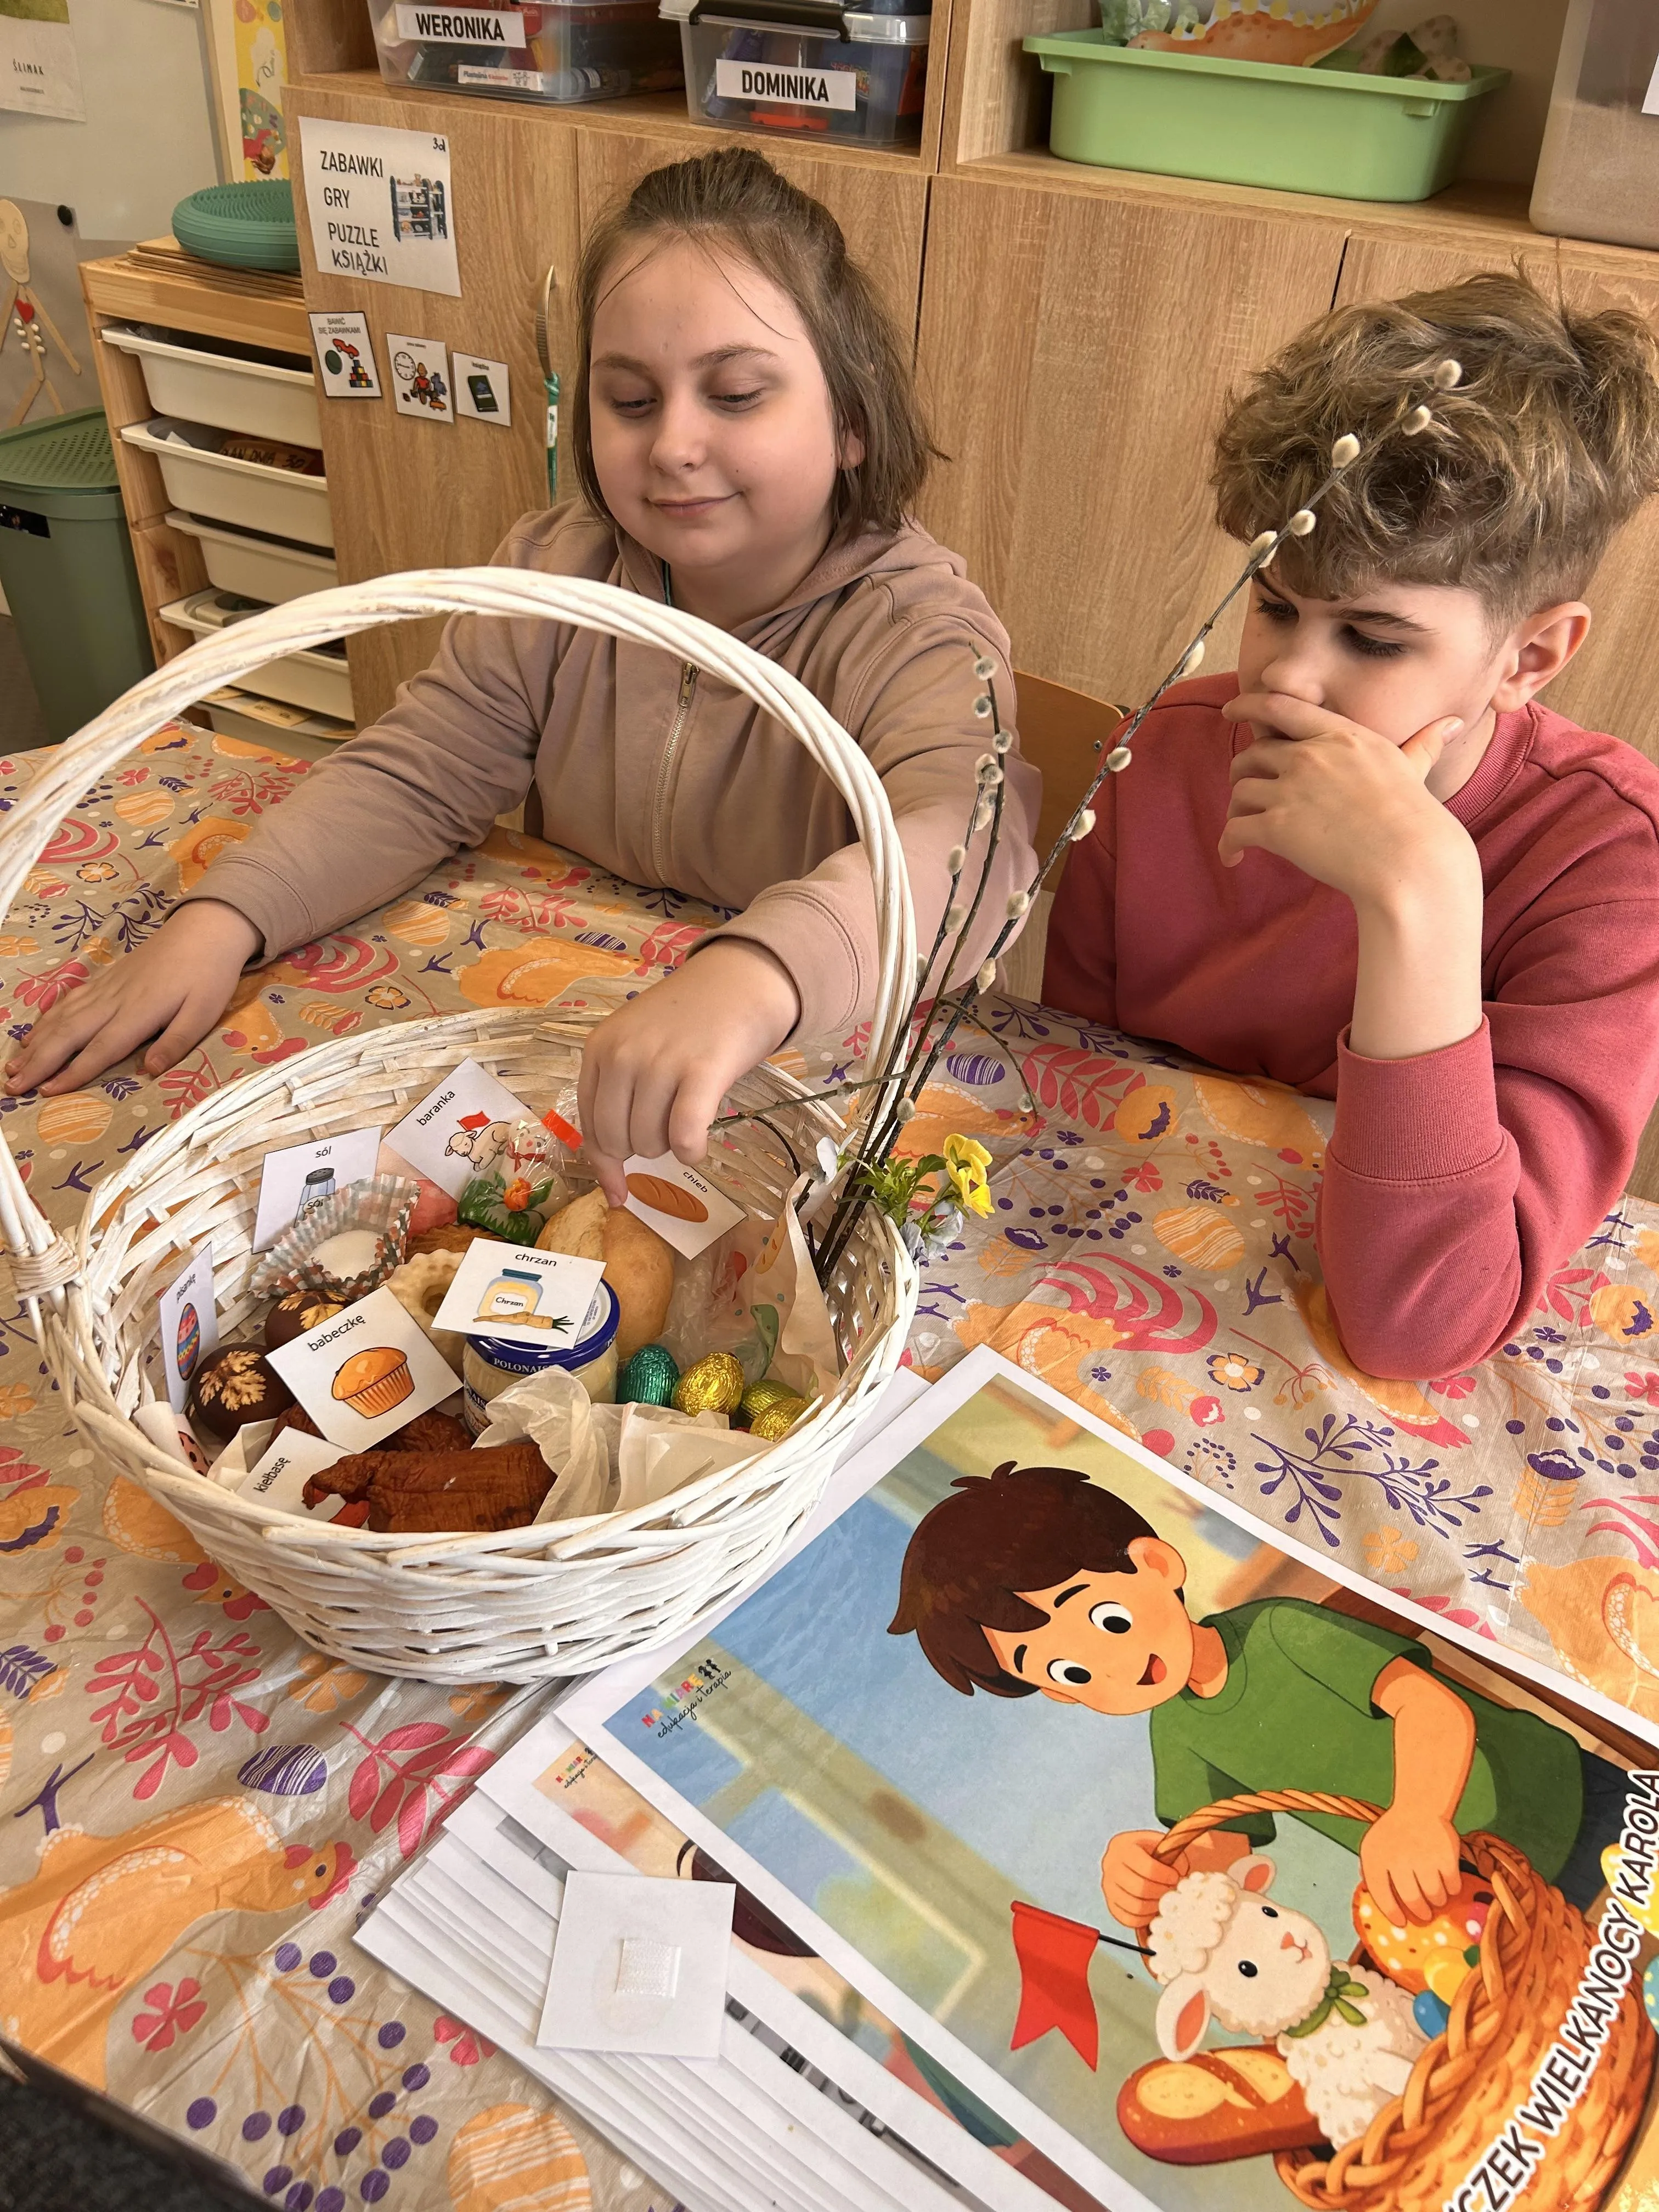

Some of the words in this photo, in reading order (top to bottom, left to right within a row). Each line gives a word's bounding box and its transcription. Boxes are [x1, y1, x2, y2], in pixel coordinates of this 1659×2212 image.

[415, 13, 505, 41] WERONIKA
[13, 58, 44, 75] ŚLIMAK
[742, 70, 829, 102] DOMINIKA
[320, 150, 383, 178] ZABAWKI
[323, 187, 350, 208] GRY
[328, 222, 380, 248] PUZZLE
[331, 249, 388, 276] KSIĄŻKI
[416, 1090, 456, 1126] baranka
[315, 1146, 332, 1158] sól
[682, 1172, 708, 1193] chleb
[515, 1252, 557, 1267] chrzan
[495, 1296, 524, 1307] Chrzan
[307, 1314, 366, 1352] babeczkę
[253, 1456, 292, 1493] kiełbasę
[1448, 2124, 1541, 2212] CZEK
[1519, 1903, 1639, 2131] WIELKANOCY
[1616, 1773, 1659, 1905] KAROLA
